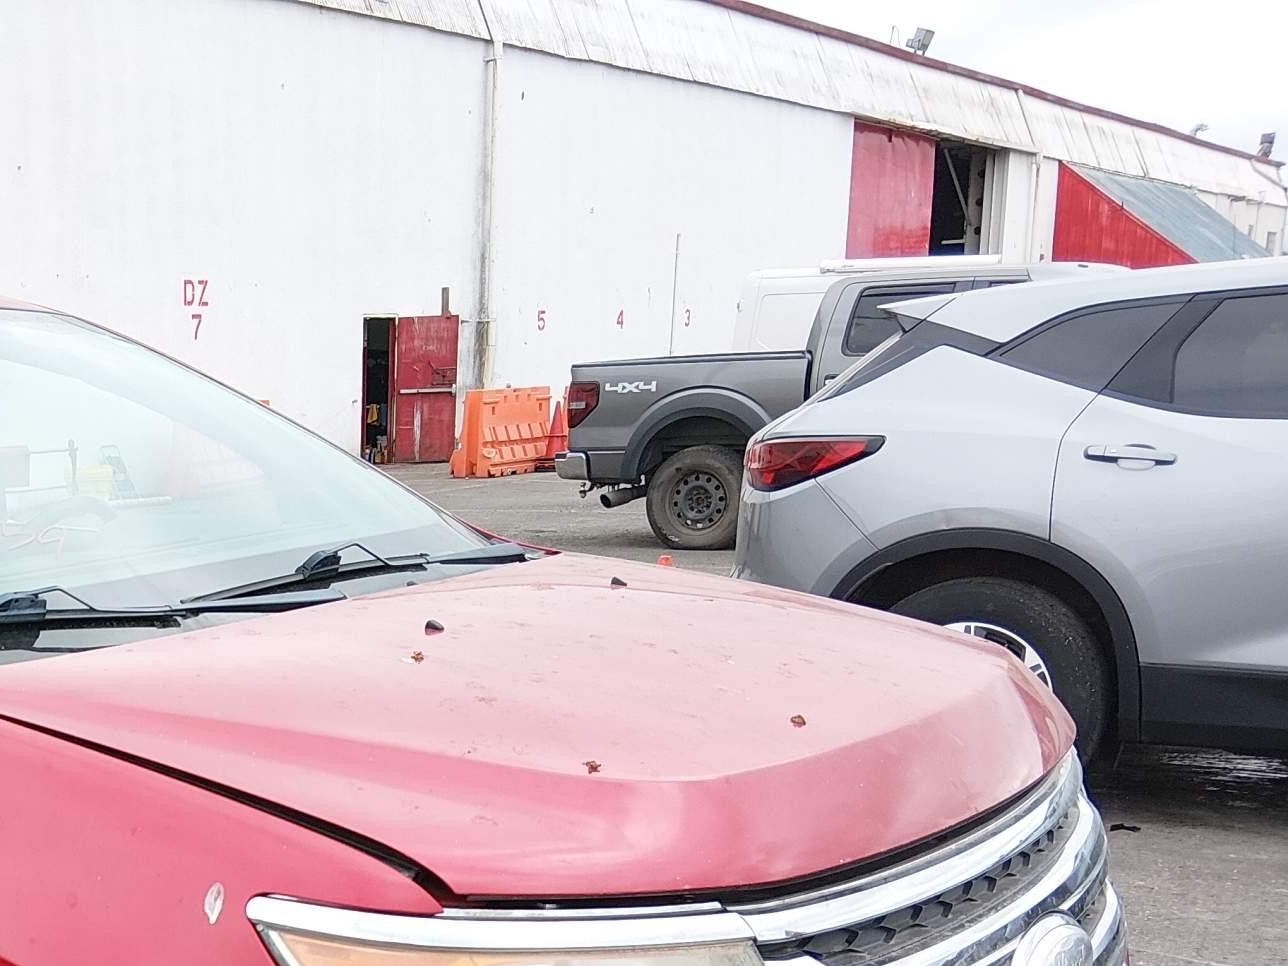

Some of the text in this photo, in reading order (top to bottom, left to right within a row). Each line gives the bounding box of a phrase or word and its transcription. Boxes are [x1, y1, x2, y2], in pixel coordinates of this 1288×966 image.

[191, 313, 202, 341] 7
[537, 310, 547, 331] 5
[616, 309, 624, 329] 4
[684, 309, 691, 327] 3
